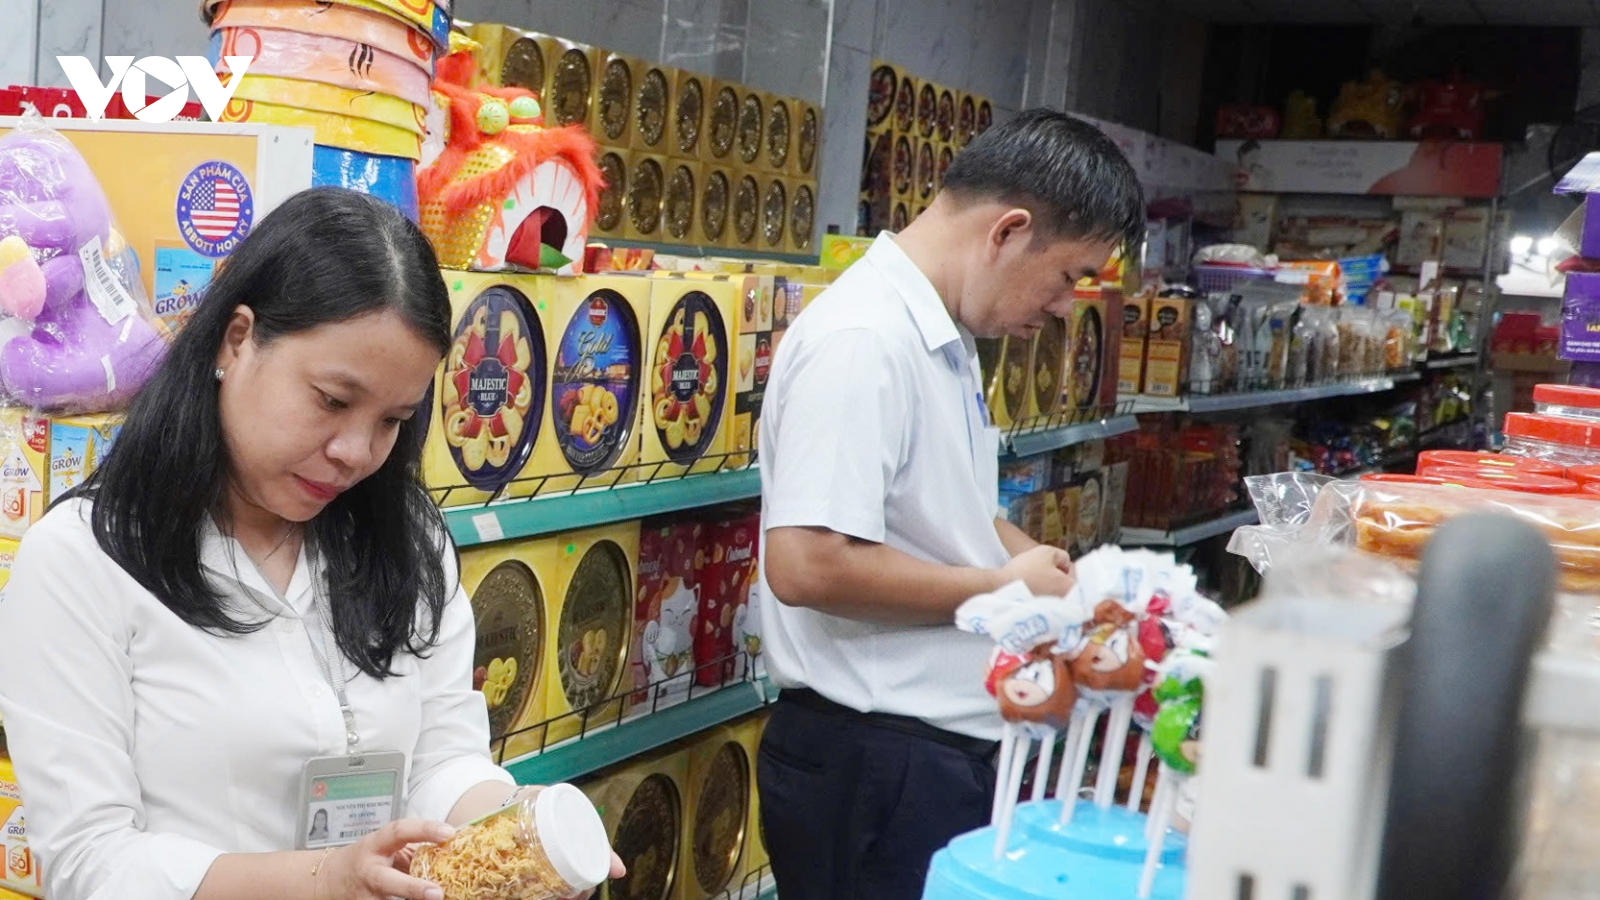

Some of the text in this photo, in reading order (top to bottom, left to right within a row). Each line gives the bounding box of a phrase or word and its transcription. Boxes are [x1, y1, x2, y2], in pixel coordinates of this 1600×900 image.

[199, 162, 232, 180] PHẨM
[232, 176, 248, 203] CỦA
[181, 220, 214, 253] ABBOTT
[216, 236, 239, 254] HOA
[471, 377, 507, 391] MAJESTIC
[480, 392, 496, 401] BLUE
[52, 456, 82, 471] GROW
[4, 468, 29, 477] GROW
[8, 825, 25, 835] GRO
